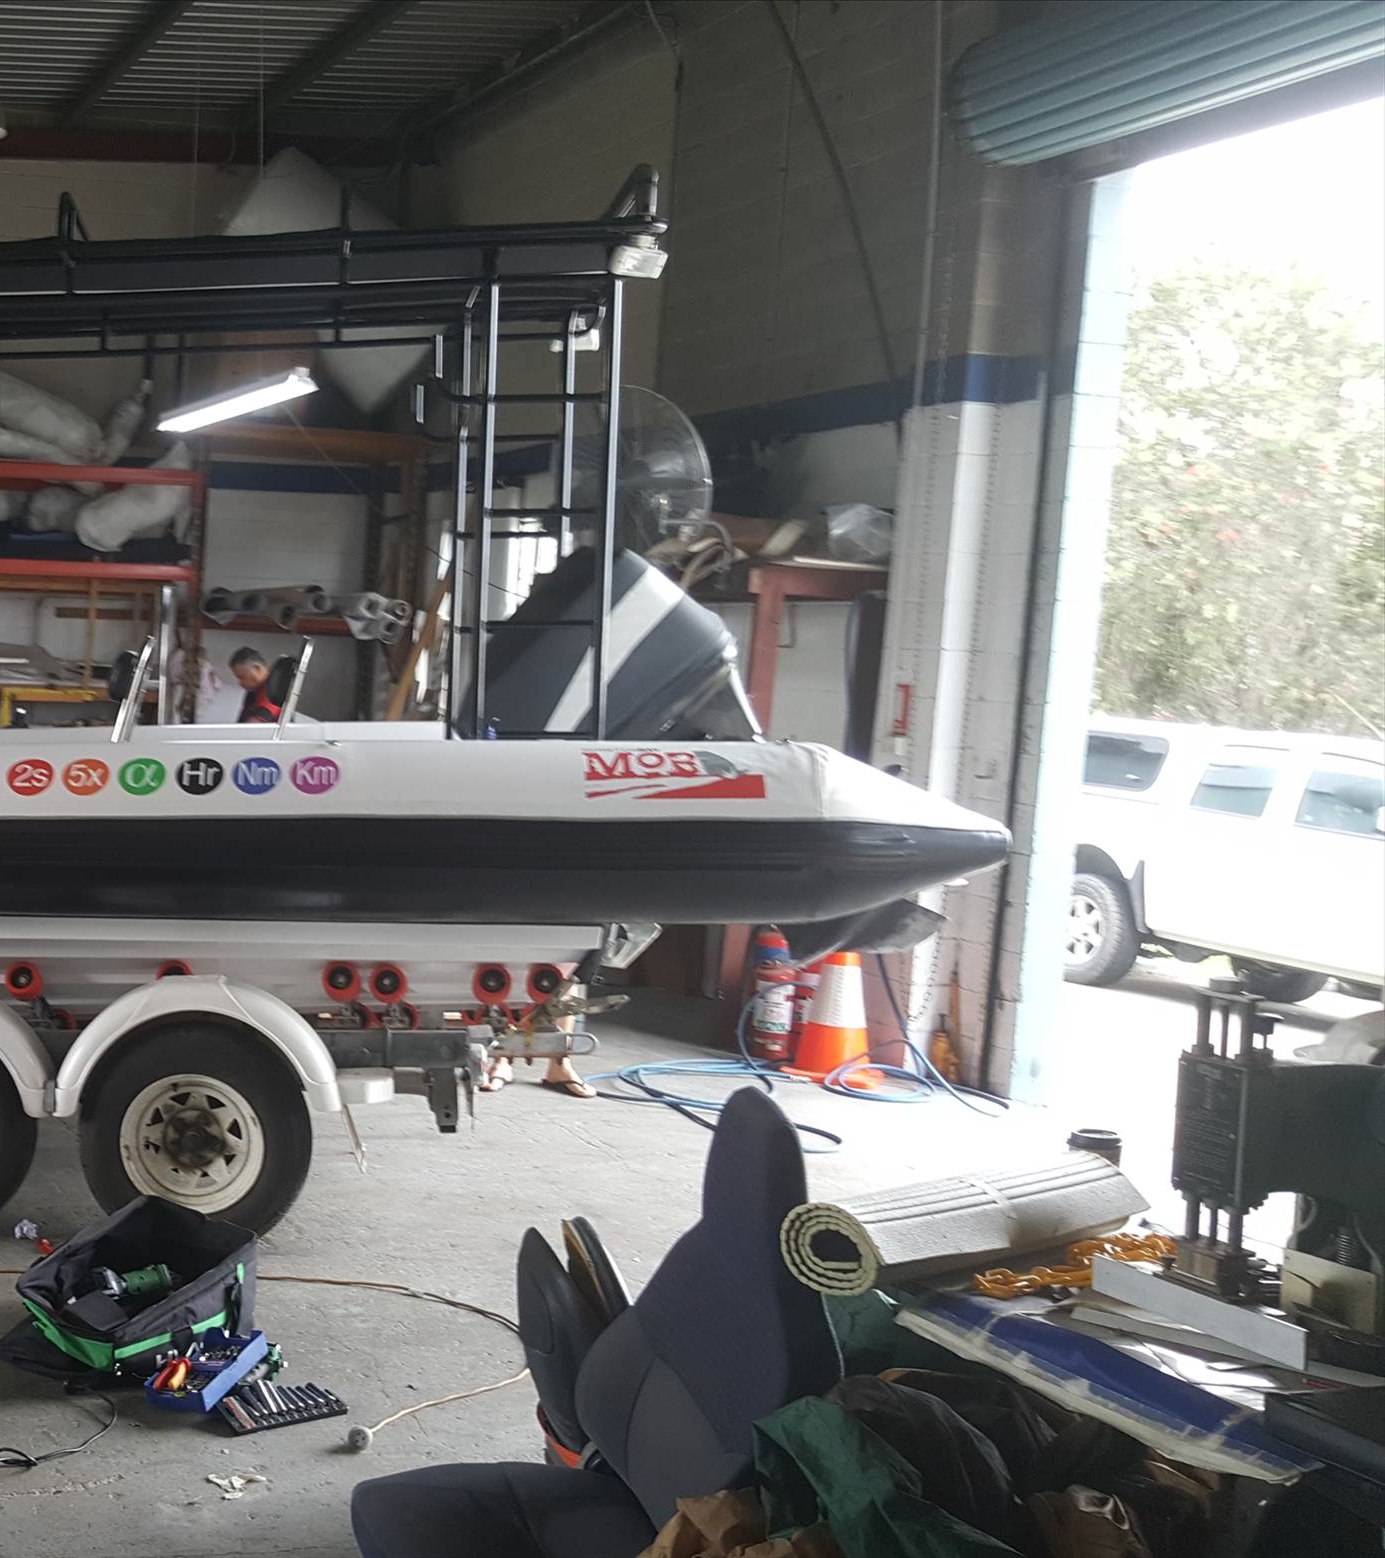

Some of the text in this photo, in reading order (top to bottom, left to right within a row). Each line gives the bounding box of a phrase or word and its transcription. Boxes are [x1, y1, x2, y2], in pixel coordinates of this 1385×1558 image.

[12, 763, 51, 788] 2s
[68, 763, 104, 788] 5x
[181, 760, 220, 786] Hr
[237, 760, 279, 786] Nm
[295, 760, 336, 786] Km
